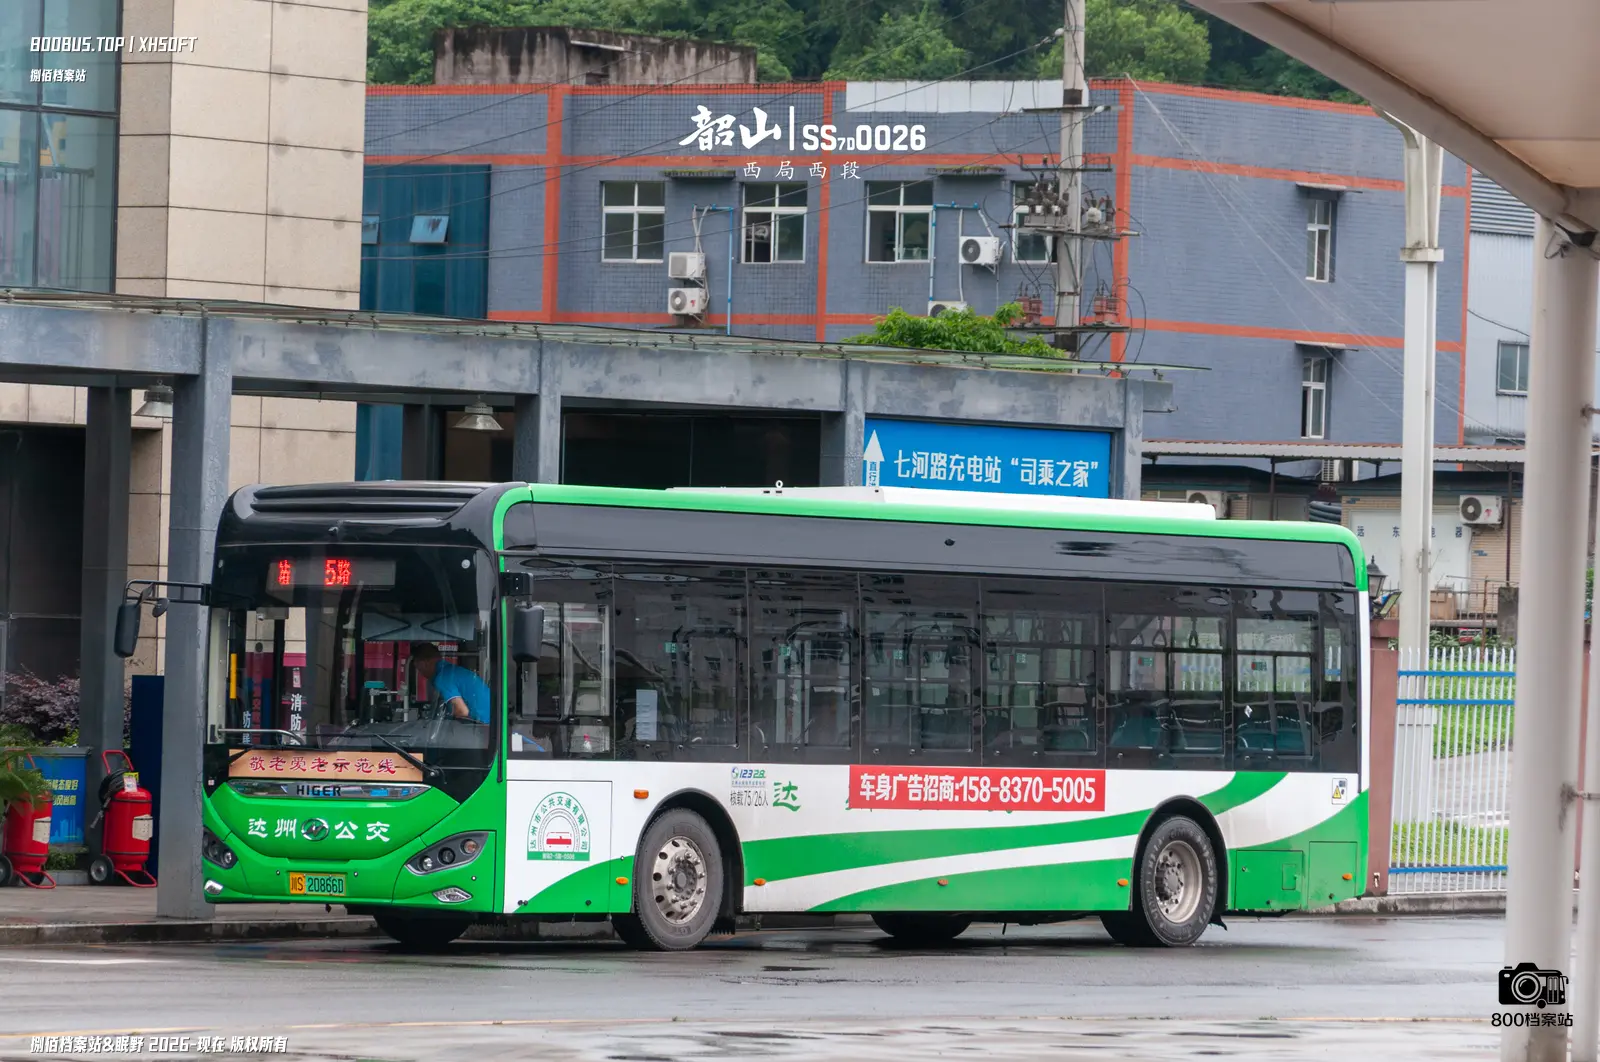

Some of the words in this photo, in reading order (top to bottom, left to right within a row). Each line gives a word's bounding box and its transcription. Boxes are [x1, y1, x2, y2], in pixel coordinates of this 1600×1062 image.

[325, 559, 352, 586] 5路
[249, 756, 396, 774] 敬老爱老示范线
[296, 785, 342, 797] HIGER
[772, 780, 802, 812] 达
[859, 772, 1096, 804] 车身广告招商:158-8370-5005
